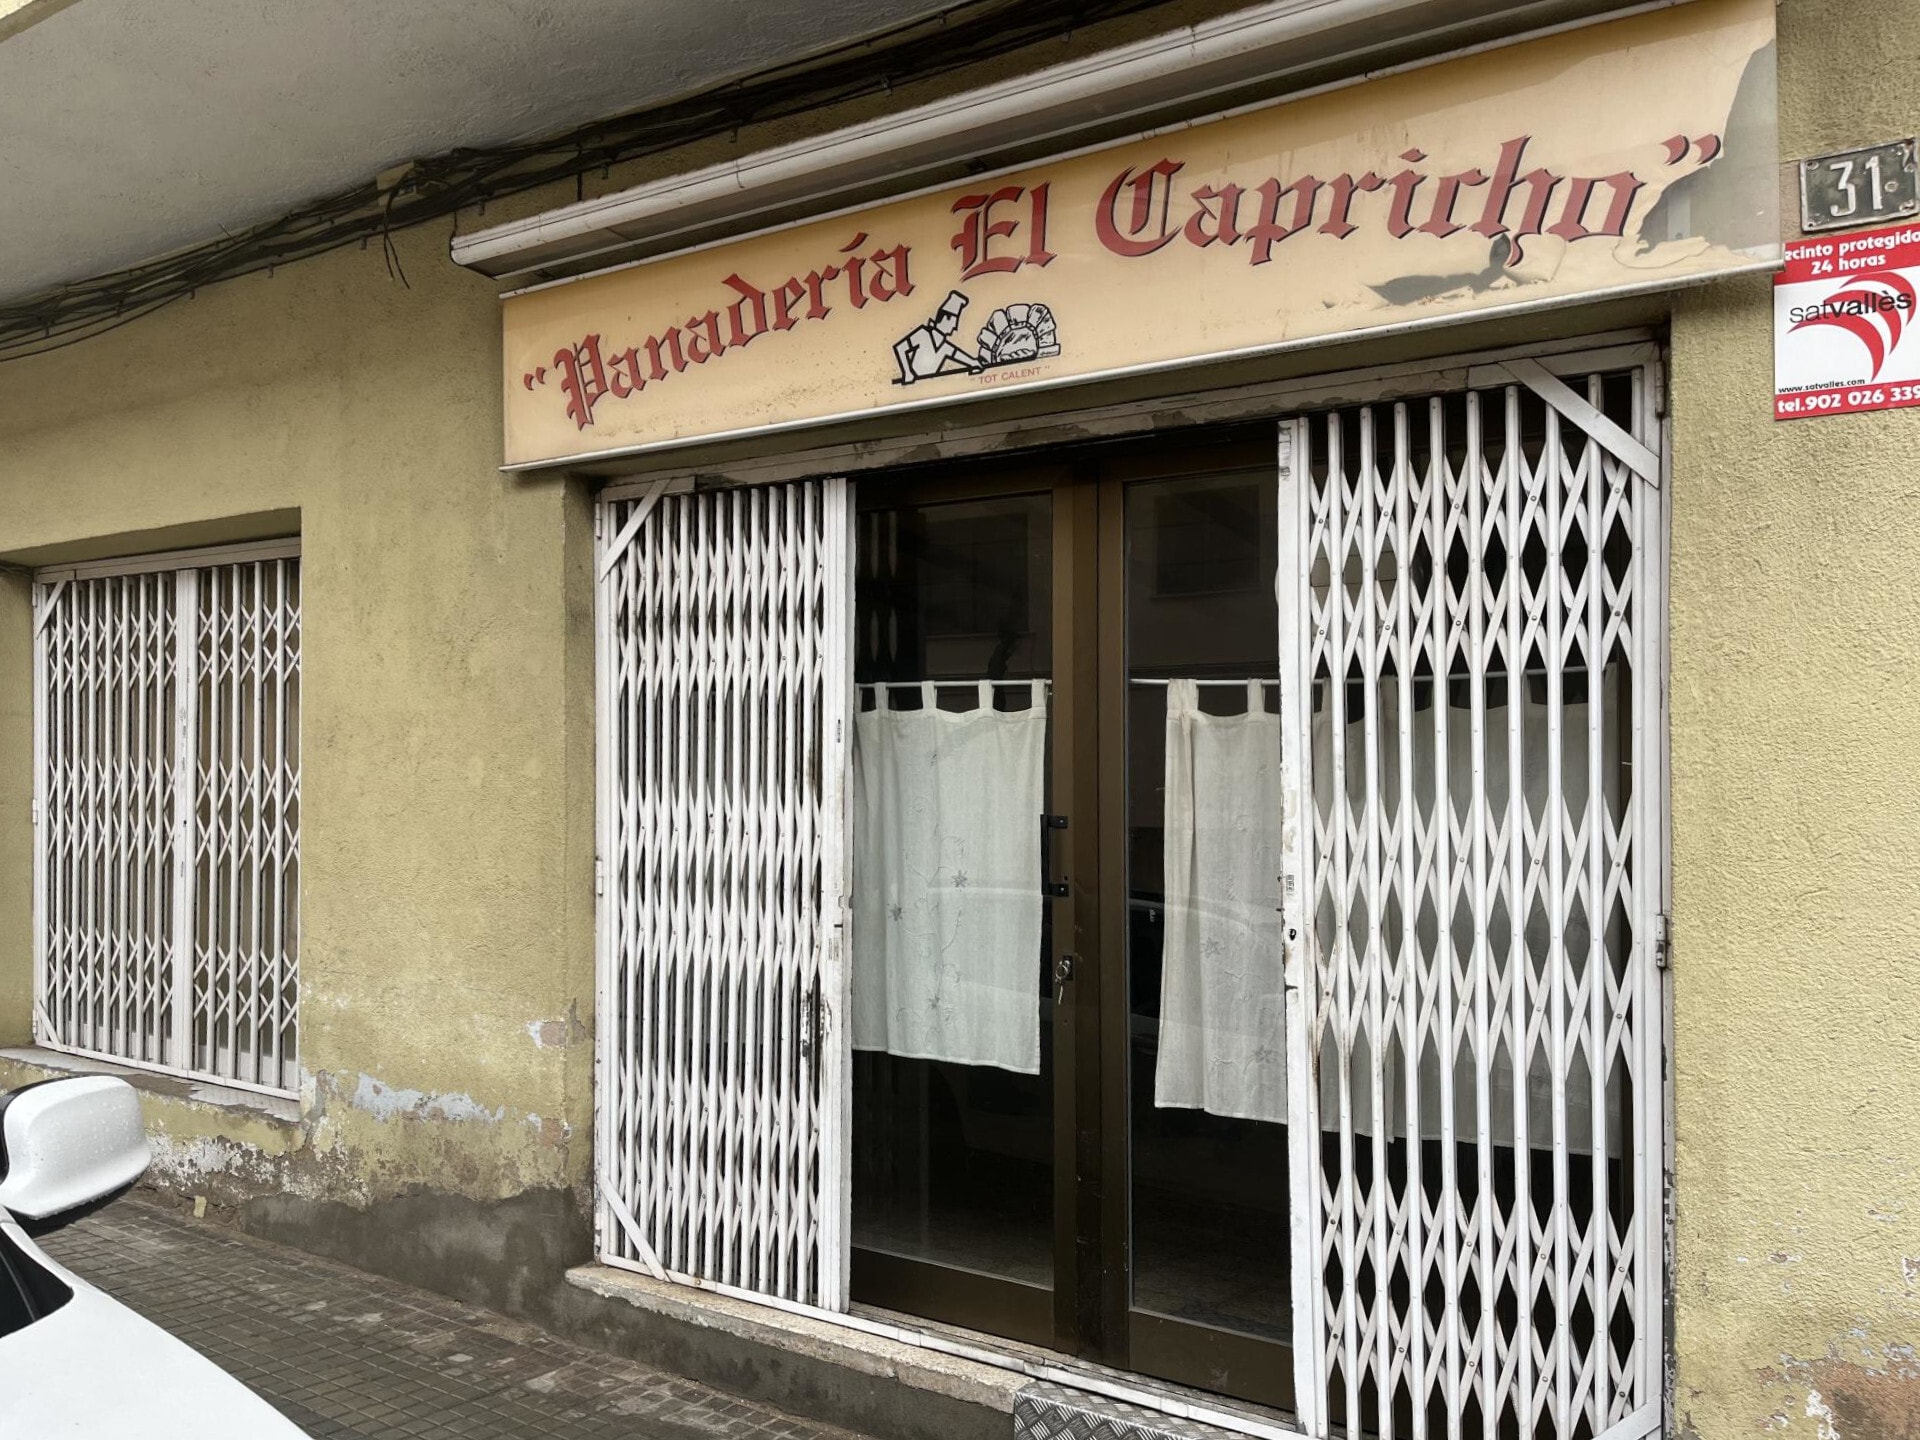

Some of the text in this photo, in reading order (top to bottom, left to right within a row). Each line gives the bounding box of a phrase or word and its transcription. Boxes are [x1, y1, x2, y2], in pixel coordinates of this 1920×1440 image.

[1830, 156, 1883, 217] 31
[950, 181, 1058, 282] El
[1784, 230, 1920, 262] ecinto protegido
[1811, 254, 1886, 275] 24 horas
[1789, 290, 1912, 323] satvallès
[1777, 384, 1920, 413] tel.902 026 339
[1778, 379, 1865, 393] www.satvalles.com
